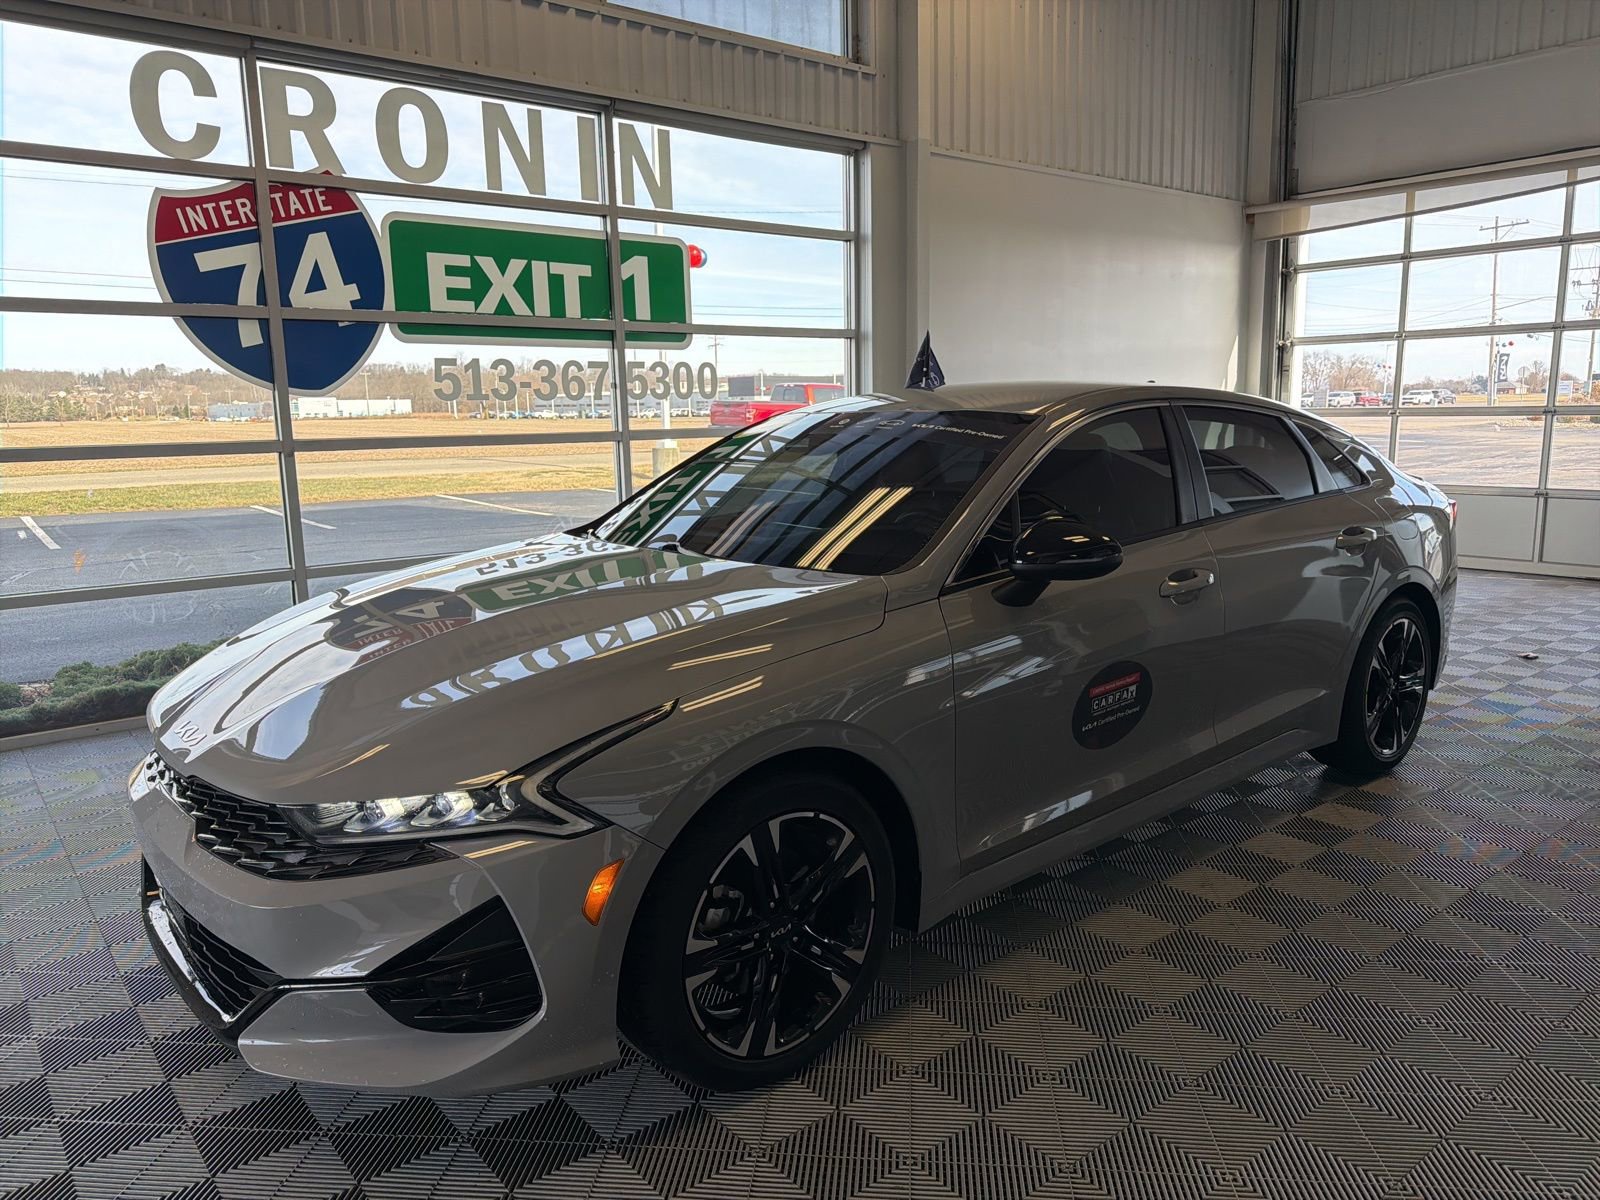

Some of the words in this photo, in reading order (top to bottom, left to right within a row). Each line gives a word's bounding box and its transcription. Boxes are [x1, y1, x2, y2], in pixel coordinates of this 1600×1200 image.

[129, 50, 674, 210] CRONIN
[175, 187, 333, 234] INTERTATE
[193, 231, 361, 348] 74
[426, 251, 593, 319] EXIT
[621, 255, 652, 321] 1
[433, 357, 718, 401] 513-3675300
[1093, 686, 1137, 710] CARFAX
